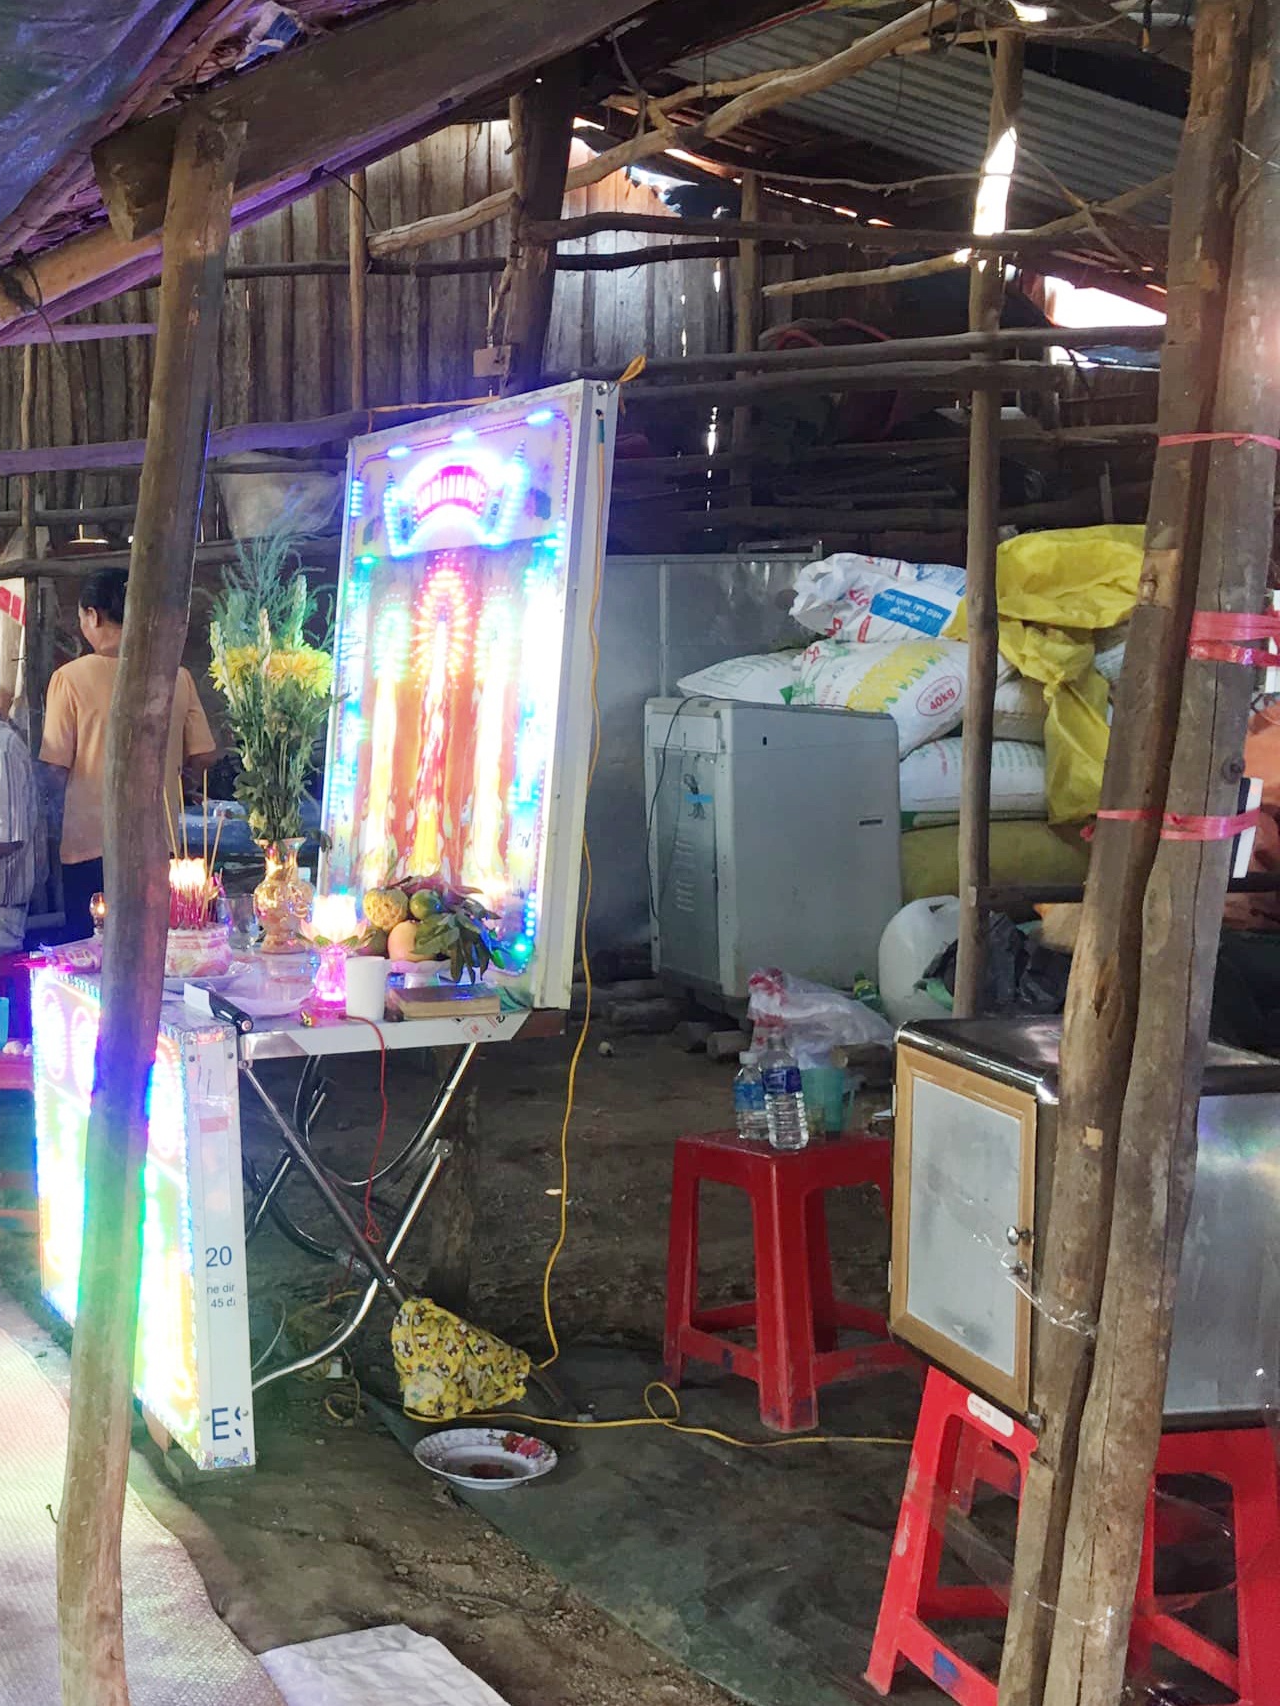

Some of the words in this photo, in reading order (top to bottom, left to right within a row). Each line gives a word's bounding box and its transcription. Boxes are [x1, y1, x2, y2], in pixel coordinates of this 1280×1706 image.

[930, 687, 956, 710] 40kg
[205, 1245, 233, 1268] 20
[210, 1297, 224, 1308] 45
